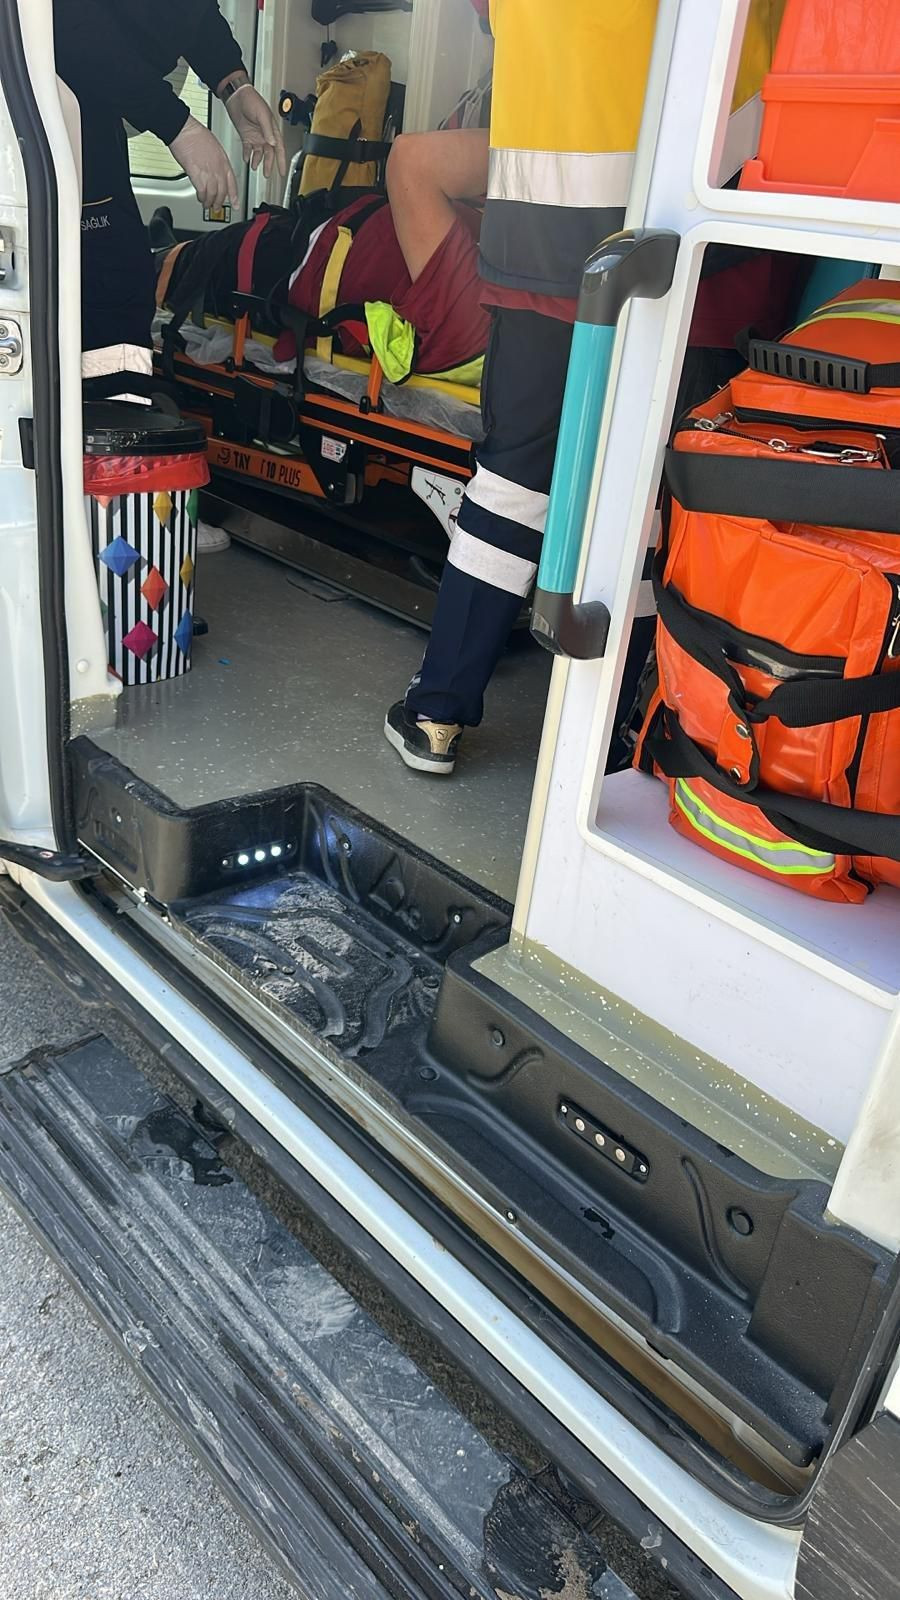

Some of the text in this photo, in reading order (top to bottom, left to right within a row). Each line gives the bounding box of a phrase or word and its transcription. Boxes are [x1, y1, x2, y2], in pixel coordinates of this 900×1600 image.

[80, 215, 110, 230] SAĞLIK
[233, 451, 250, 470] TAY
[279, 465, 301, 487] PLUS
